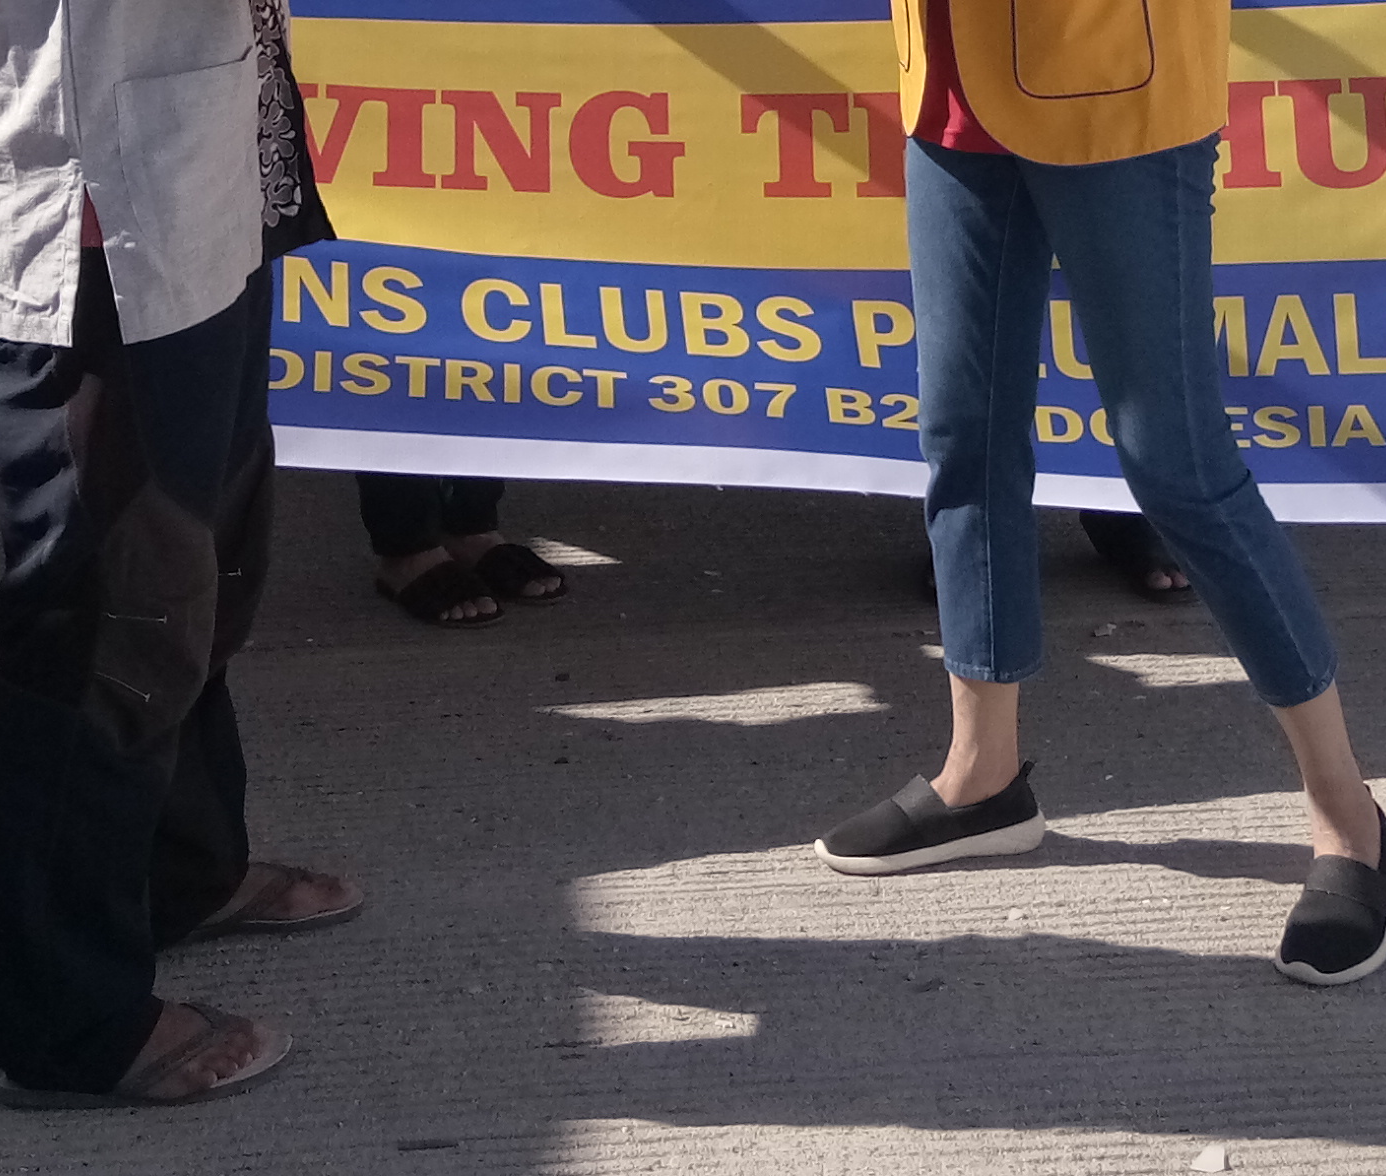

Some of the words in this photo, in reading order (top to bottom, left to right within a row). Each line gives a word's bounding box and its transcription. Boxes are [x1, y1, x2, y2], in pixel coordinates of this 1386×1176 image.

[461, 278, 822, 363] CLUBS
[269, 348, 628, 409] DISTRICT
[648, 375, 797, 419] 307
